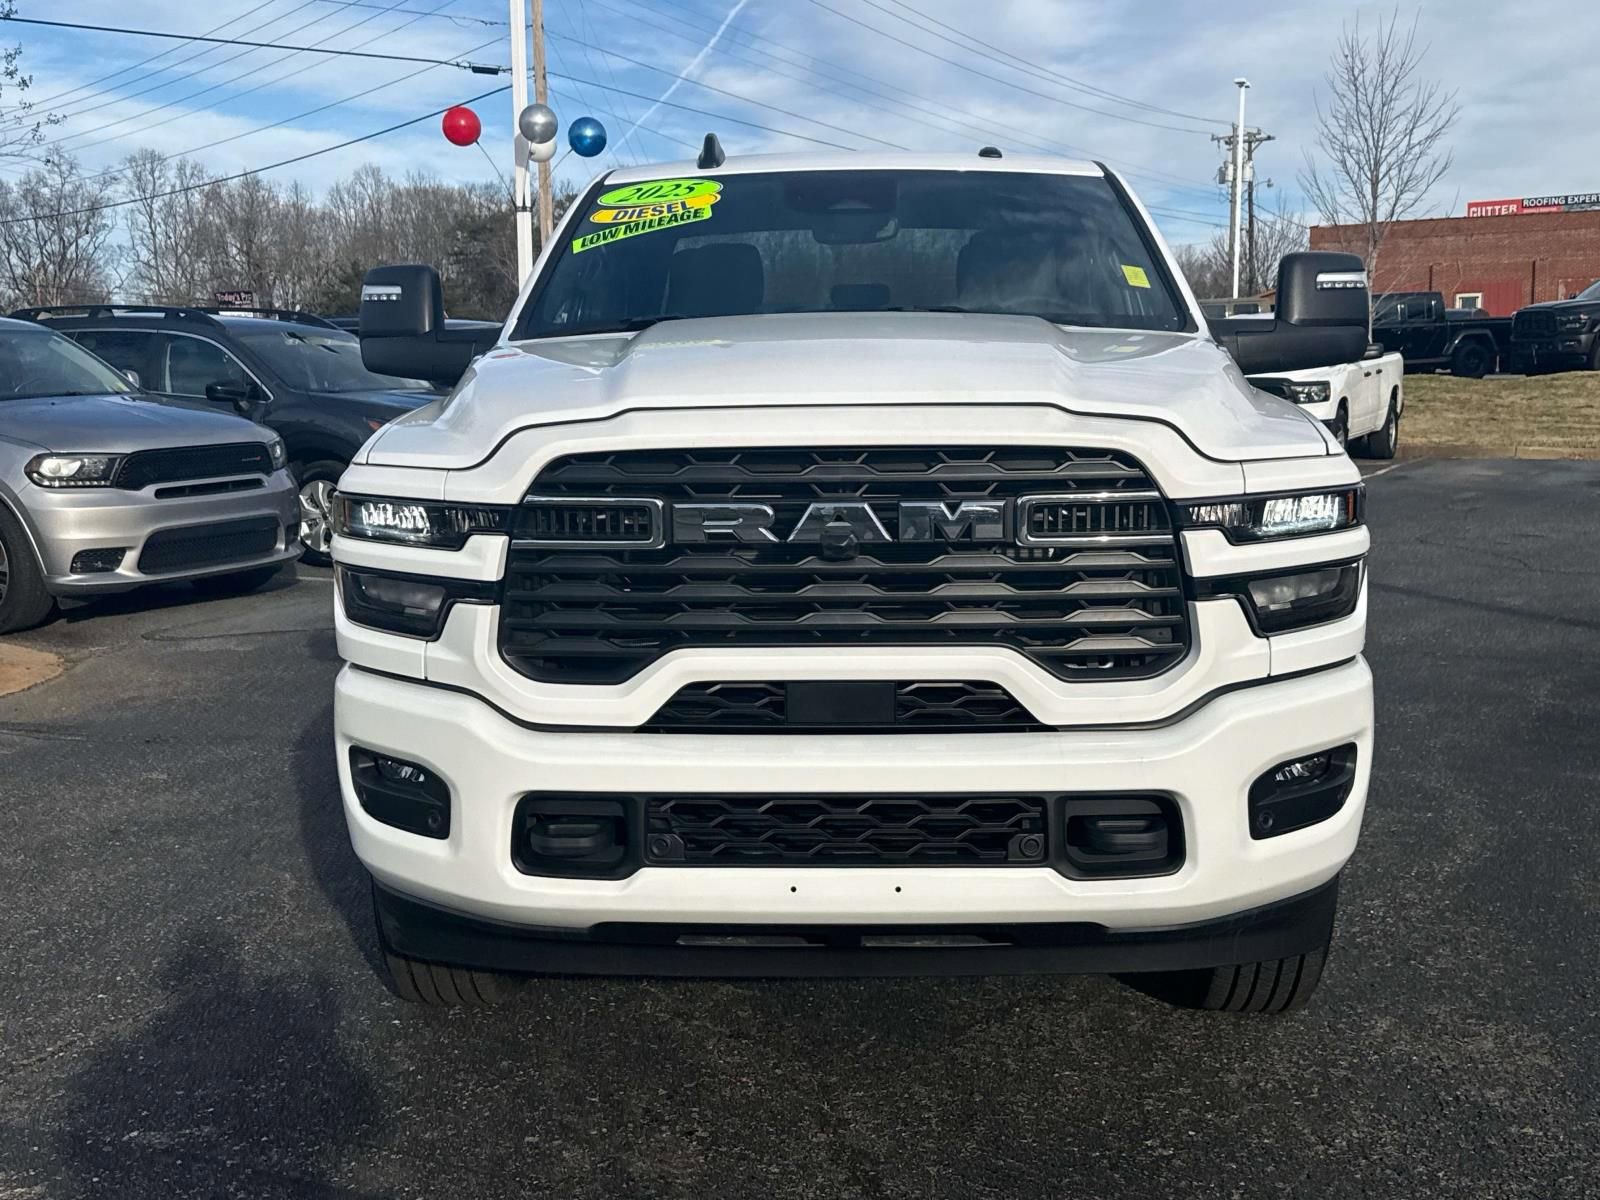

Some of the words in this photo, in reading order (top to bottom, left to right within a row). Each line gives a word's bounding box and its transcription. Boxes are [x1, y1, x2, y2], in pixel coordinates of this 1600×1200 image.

[614, 182, 704, 203] 2025
[1523, 197, 1565, 207] ROOFING
[612, 201, 694, 221] DIESEL
[580, 227, 622, 248] LOW
[623, 207, 705, 235] MILEAGE
[673, 502, 1006, 543] RAM
